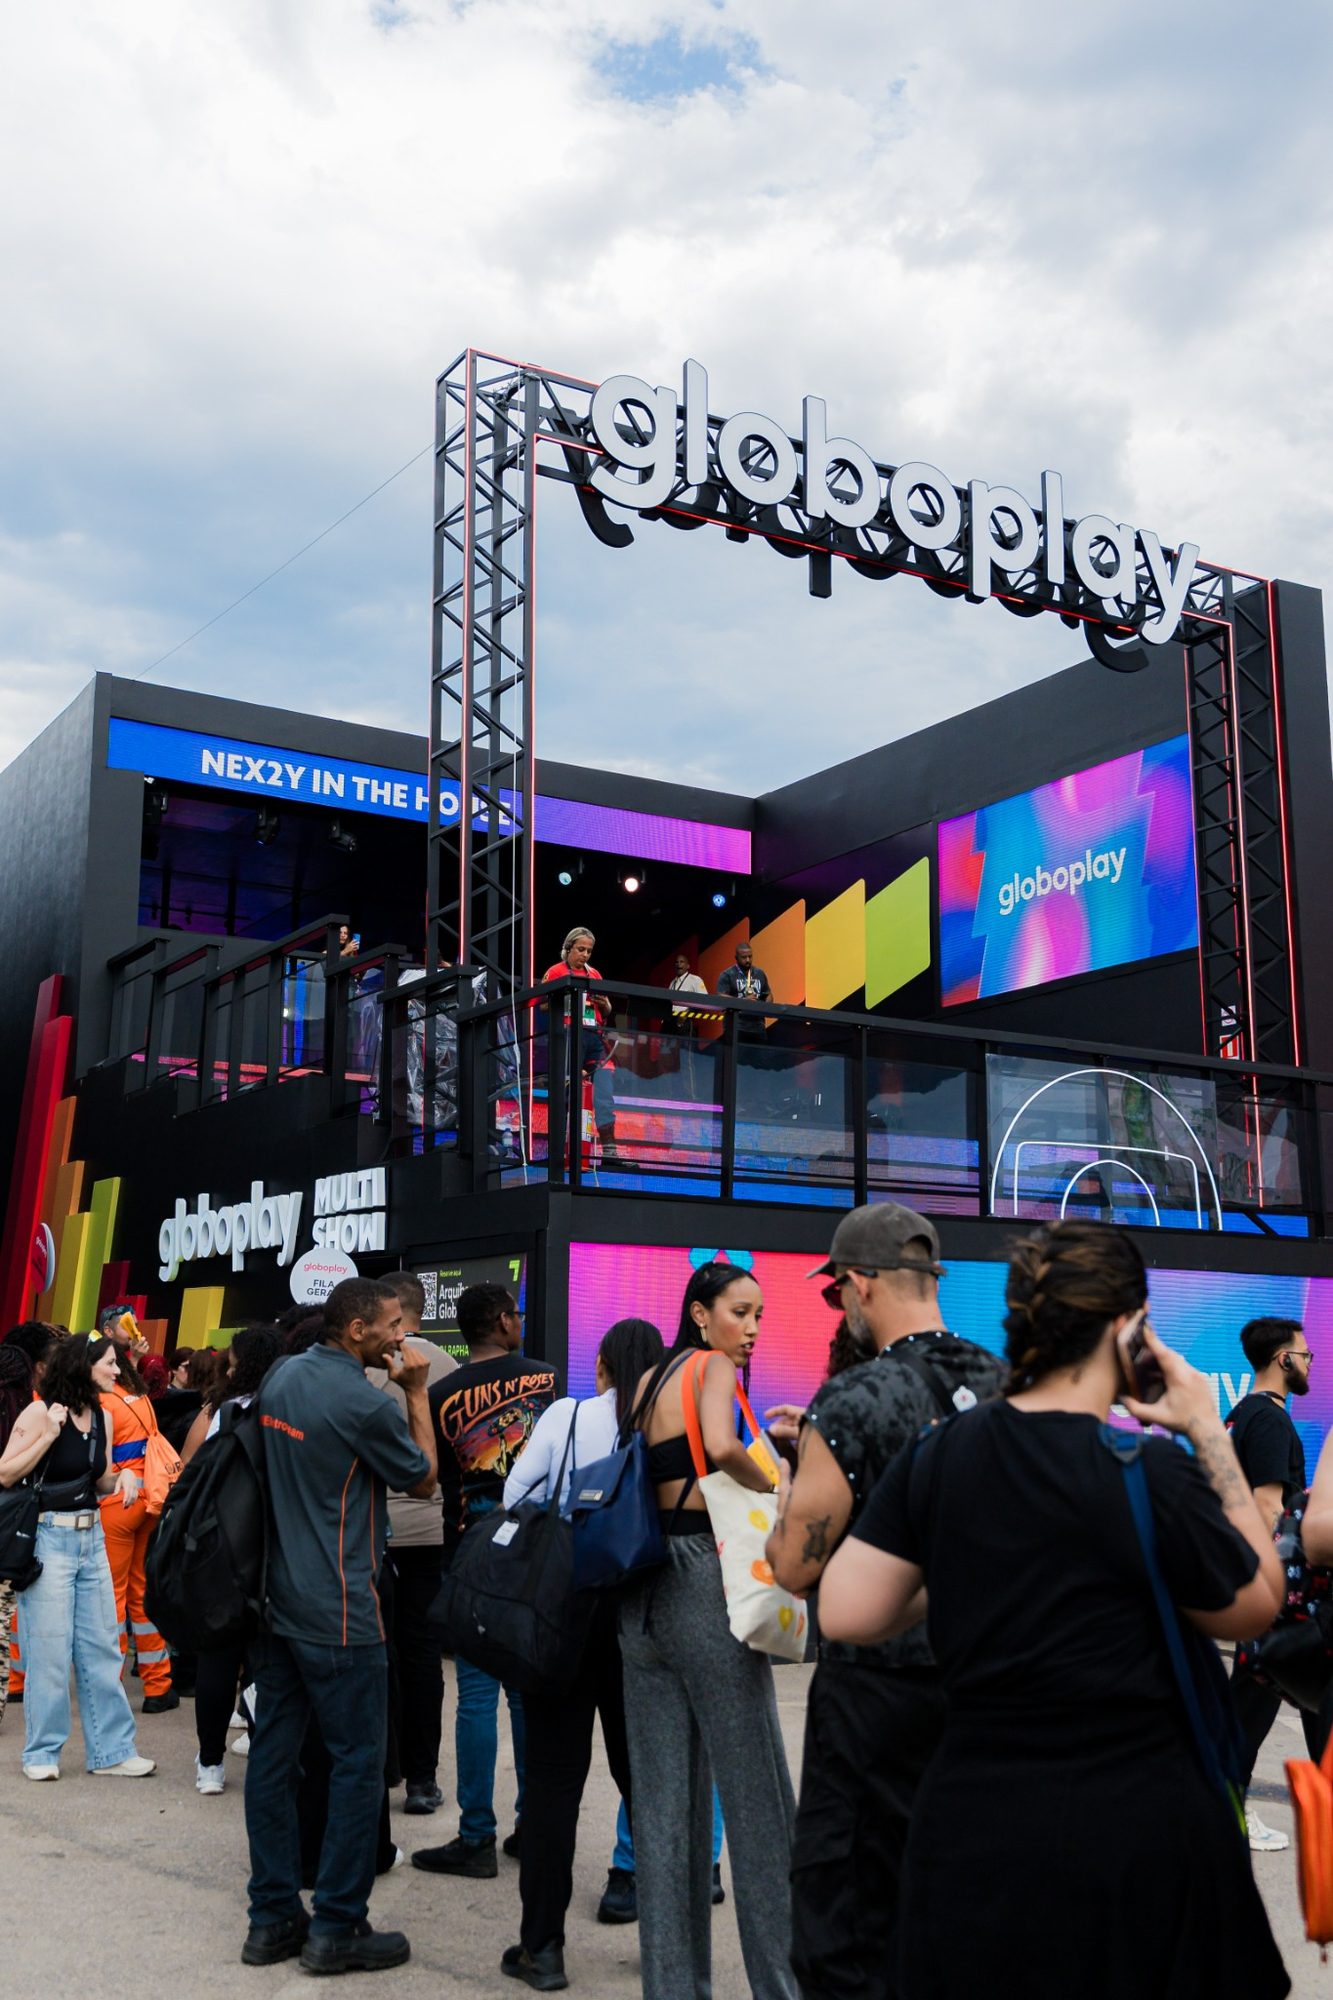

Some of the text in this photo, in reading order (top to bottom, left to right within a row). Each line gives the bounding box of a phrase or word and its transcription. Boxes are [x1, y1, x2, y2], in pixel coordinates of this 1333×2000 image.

[589, 357, 1201, 645] globoplay
[201, 748, 306, 789] NEX2Y
[312, 768, 345, 798] IN
[352, 775, 408, 808] THE
[997, 847, 1127, 916] globoplay
[313, 1167, 387, 1217] MULTI
[158, 1180, 303, 1282] globoplay
[312, 1211, 387, 1254] SHOW
[303, 1262, 348, 1275] globoplay
[306, 1287, 334, 1297] GERA
[313, 1279, 335, 1288] FILA
[440, 1380, 501, 1441] GUNS
[520, 1372, 555, 1393] ROSES
